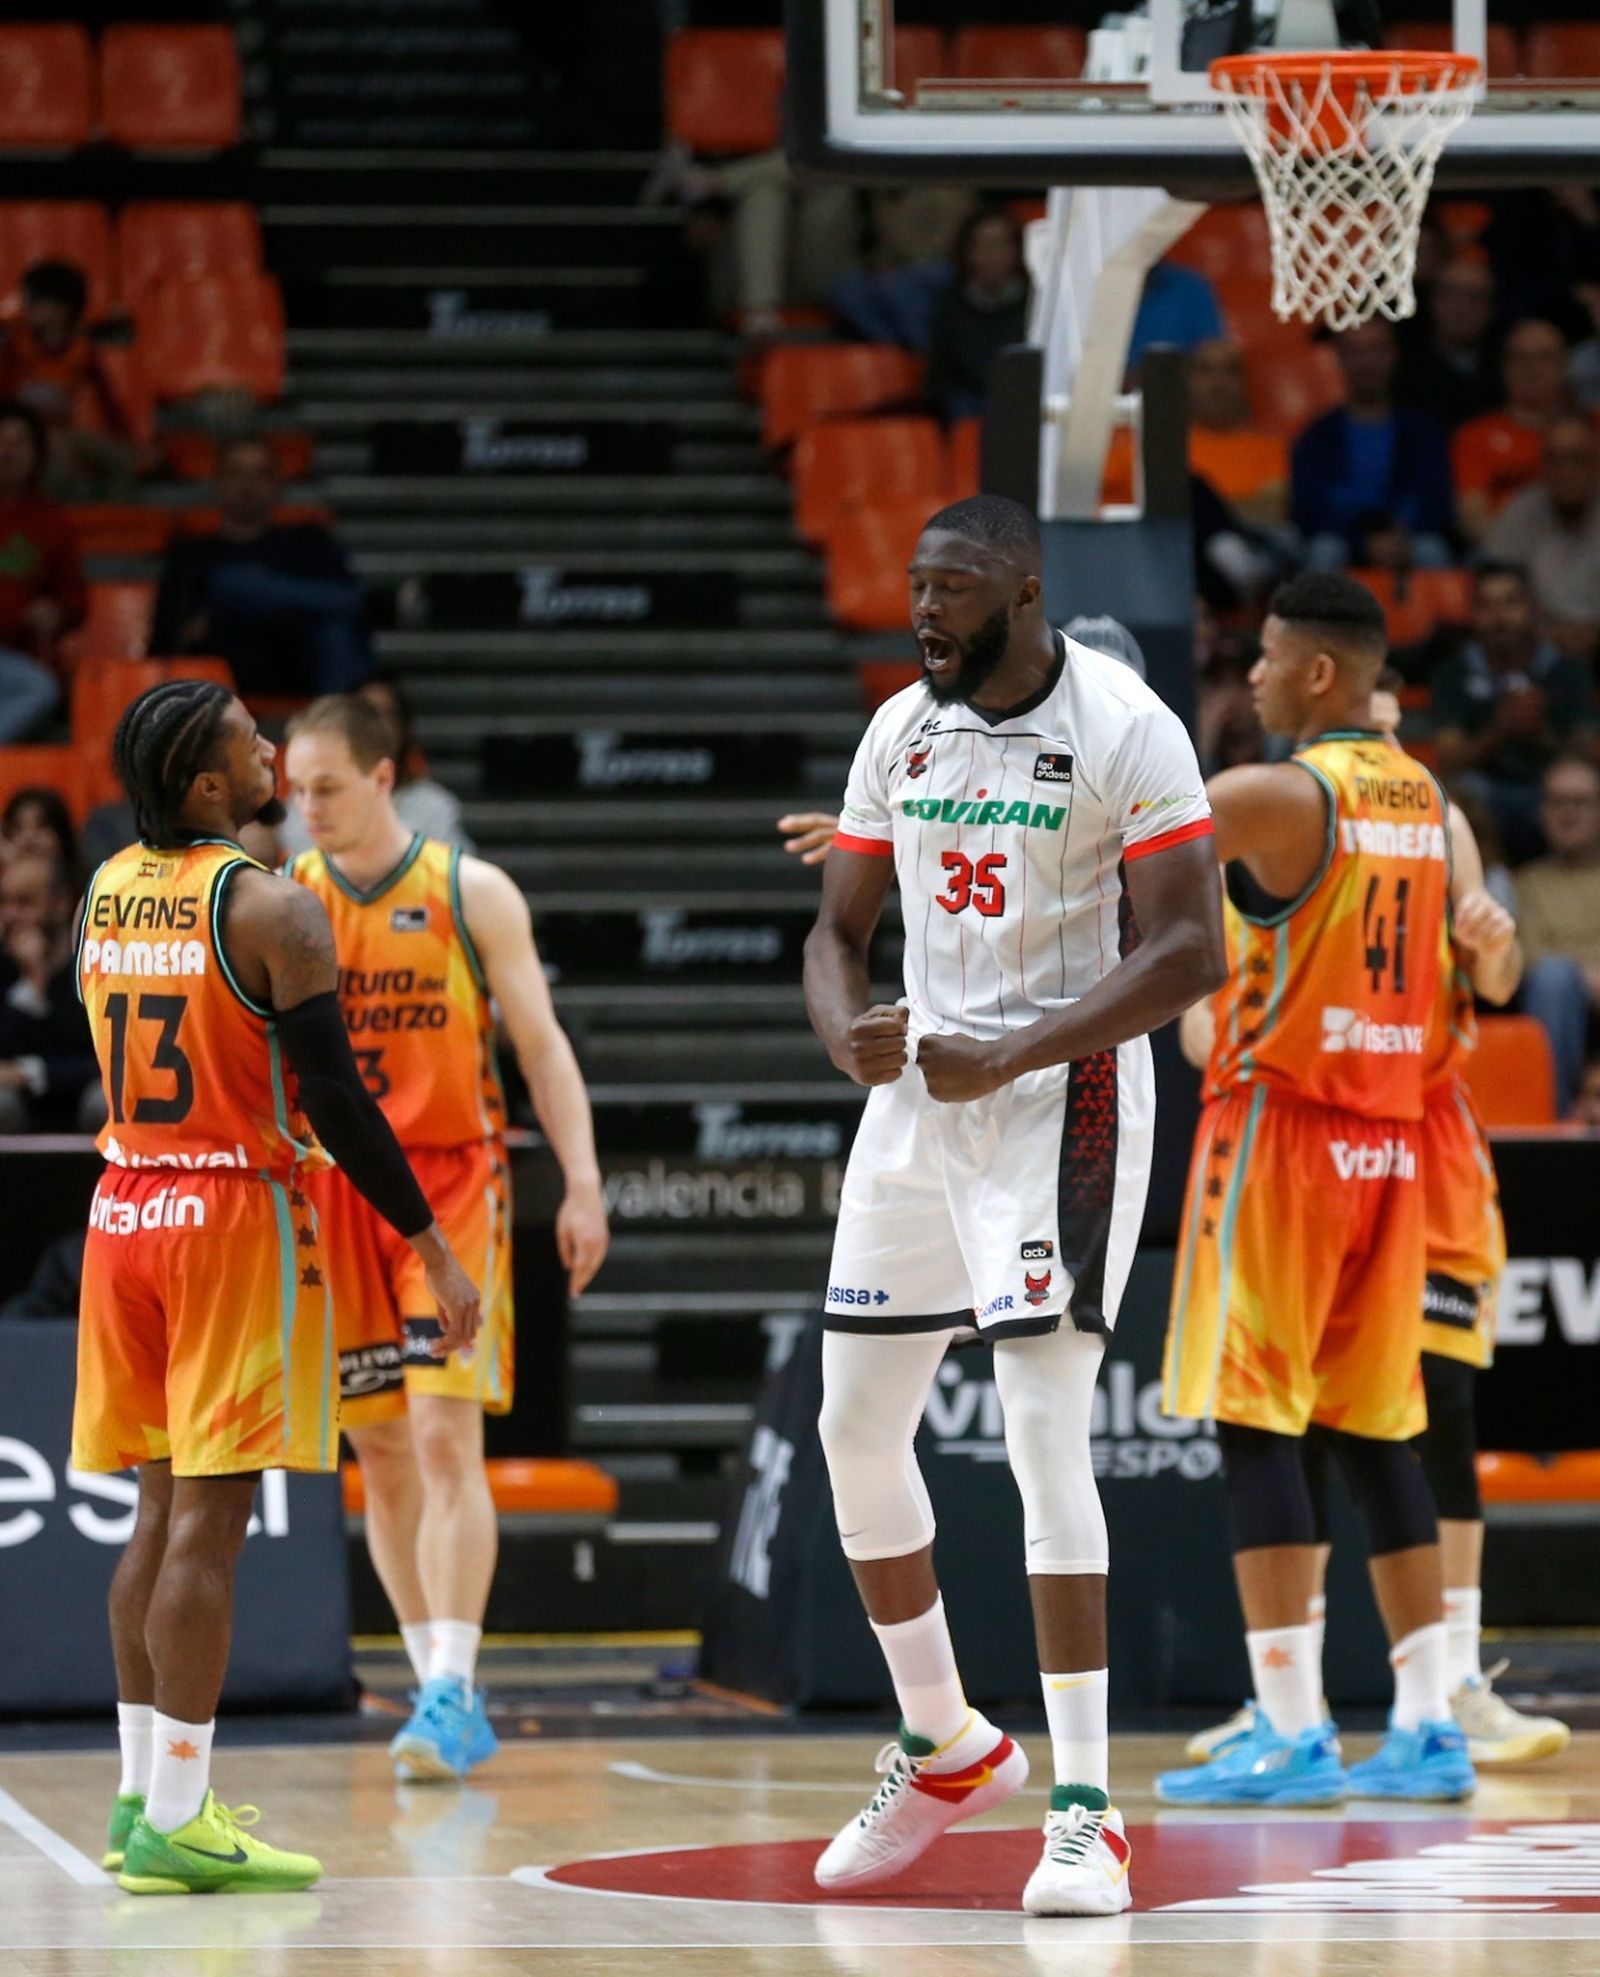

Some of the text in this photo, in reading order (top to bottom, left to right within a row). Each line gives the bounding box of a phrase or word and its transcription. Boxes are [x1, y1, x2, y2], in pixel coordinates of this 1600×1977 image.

[1035, 769, 1071, 780] endesa
[1355, 776, 1431, 810] RIVERO
[936, 851, 1006, 917] 35
[94, 895, 199, 930] EVANS
[1363, 876, 1410, 994] 41
[84, 939, 206, 976] PAMESA
[346, 1002, 448, 1033] uerzo
[103, 994, 193, 1124] 13
[691, 1101, 843, 1160] Torres
[1023, 1247, 1047, 1258] acb
